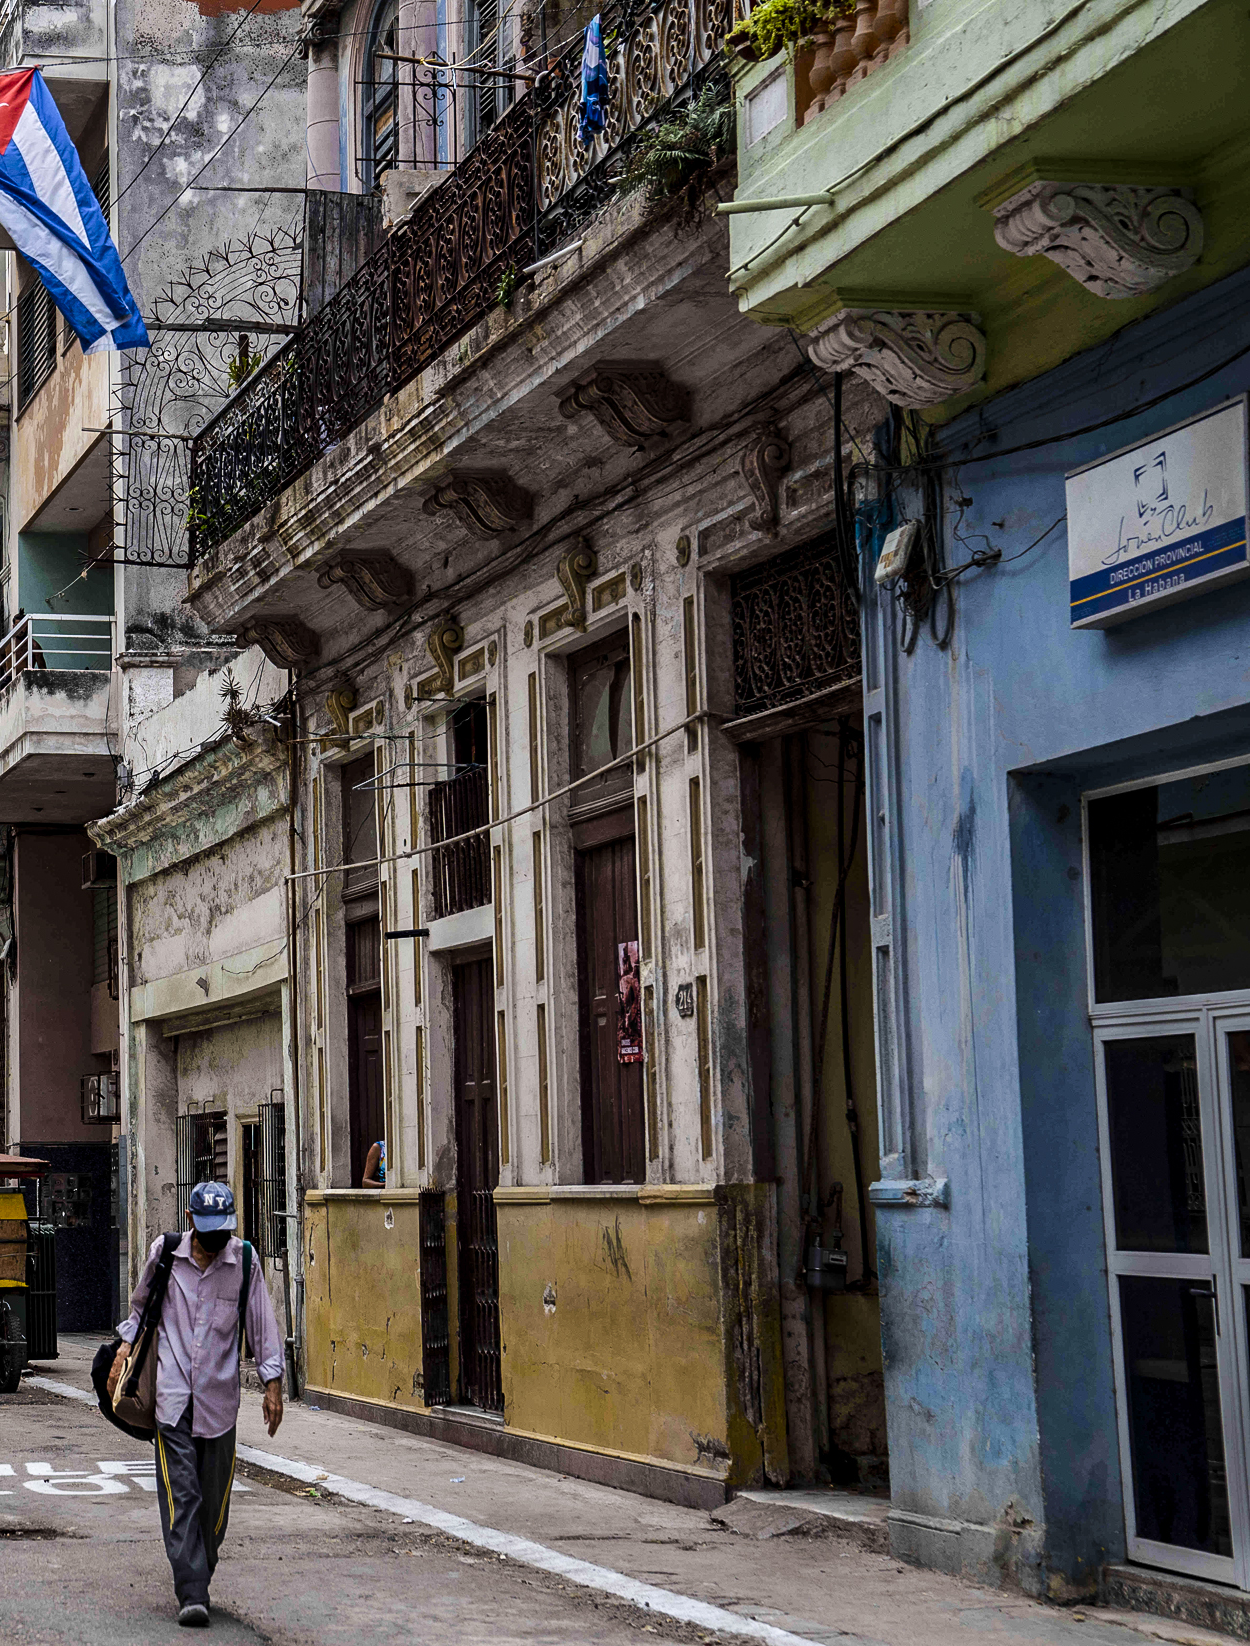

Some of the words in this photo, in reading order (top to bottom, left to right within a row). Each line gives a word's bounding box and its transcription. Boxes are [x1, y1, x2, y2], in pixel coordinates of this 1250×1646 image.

[1101, 516, 1163, 565] Joven
[1157, 489, 1213, 536] Club
[1110, 556, 1153, 584] DIRECCIÓN
[1154, 541, 1204, 568] PROVINCIAL
[1128, 589, 1141, 602] La
[1145, 573, 1185, 596] Habana
[679, 989, 691, 1010] 214
[203, 1193, 225, 1210] NY
